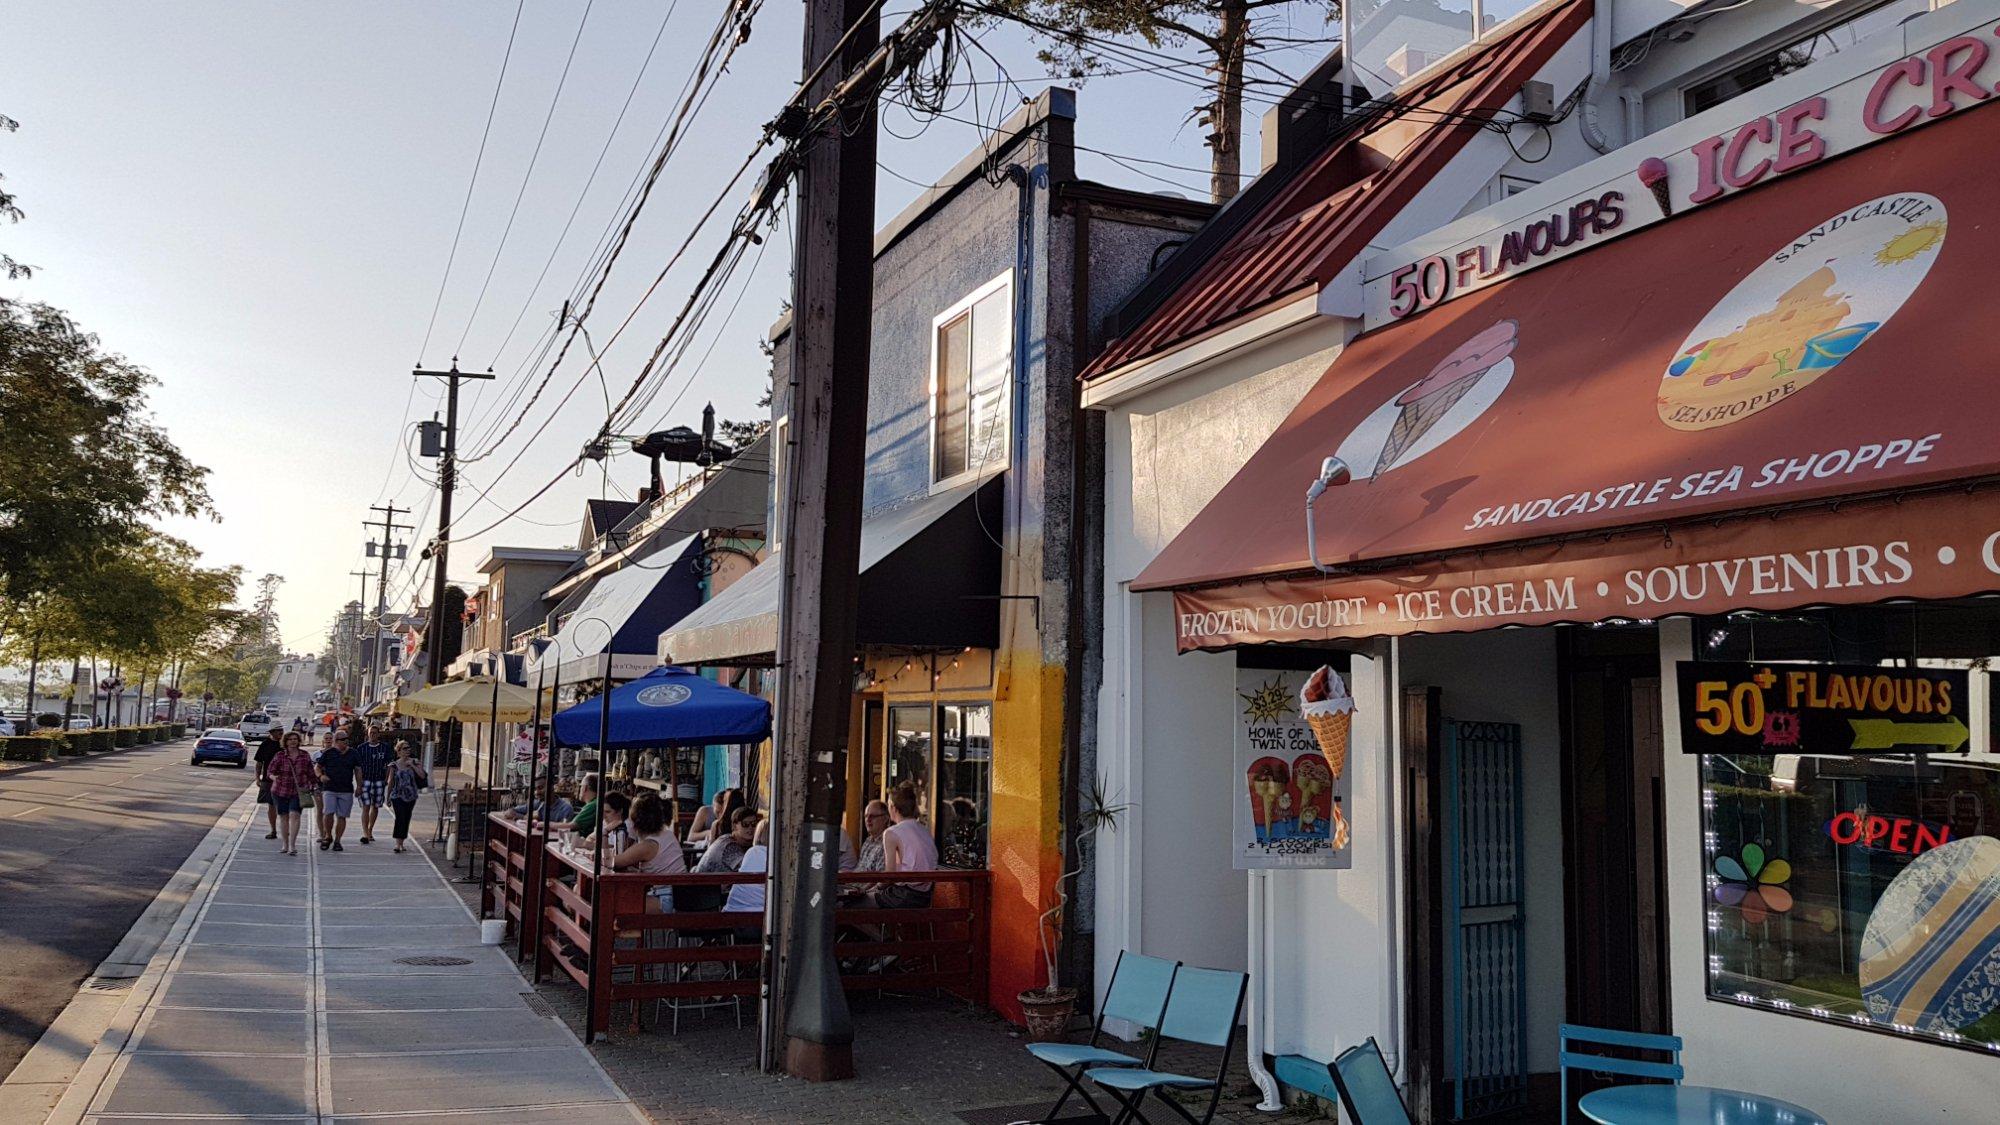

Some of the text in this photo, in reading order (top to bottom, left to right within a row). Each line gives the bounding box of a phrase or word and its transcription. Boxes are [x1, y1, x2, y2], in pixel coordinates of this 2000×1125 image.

[1390, 25, 2000, 318] 50 FLAVOURS ICE CR
[1774, 196, 1933, 264] SANDCASTLE
[1463, 432, 1943, 534] SANDCASTLE SEA SHOPPE
[1180, 541, 1913, 638] FROZEN YOGURT ICE CREAM SOUVENIRS
[1253, 688, 1283, 710] $3.29
[1787, 671, 1952, 715] FLAVOURS
[1248, 727, 1283, 739] HOME
[1288, 728, 1303, 740] OF
[1250, 738, 1286, 750] TWIN
[1830, 811, 1951, 855] OPEN
